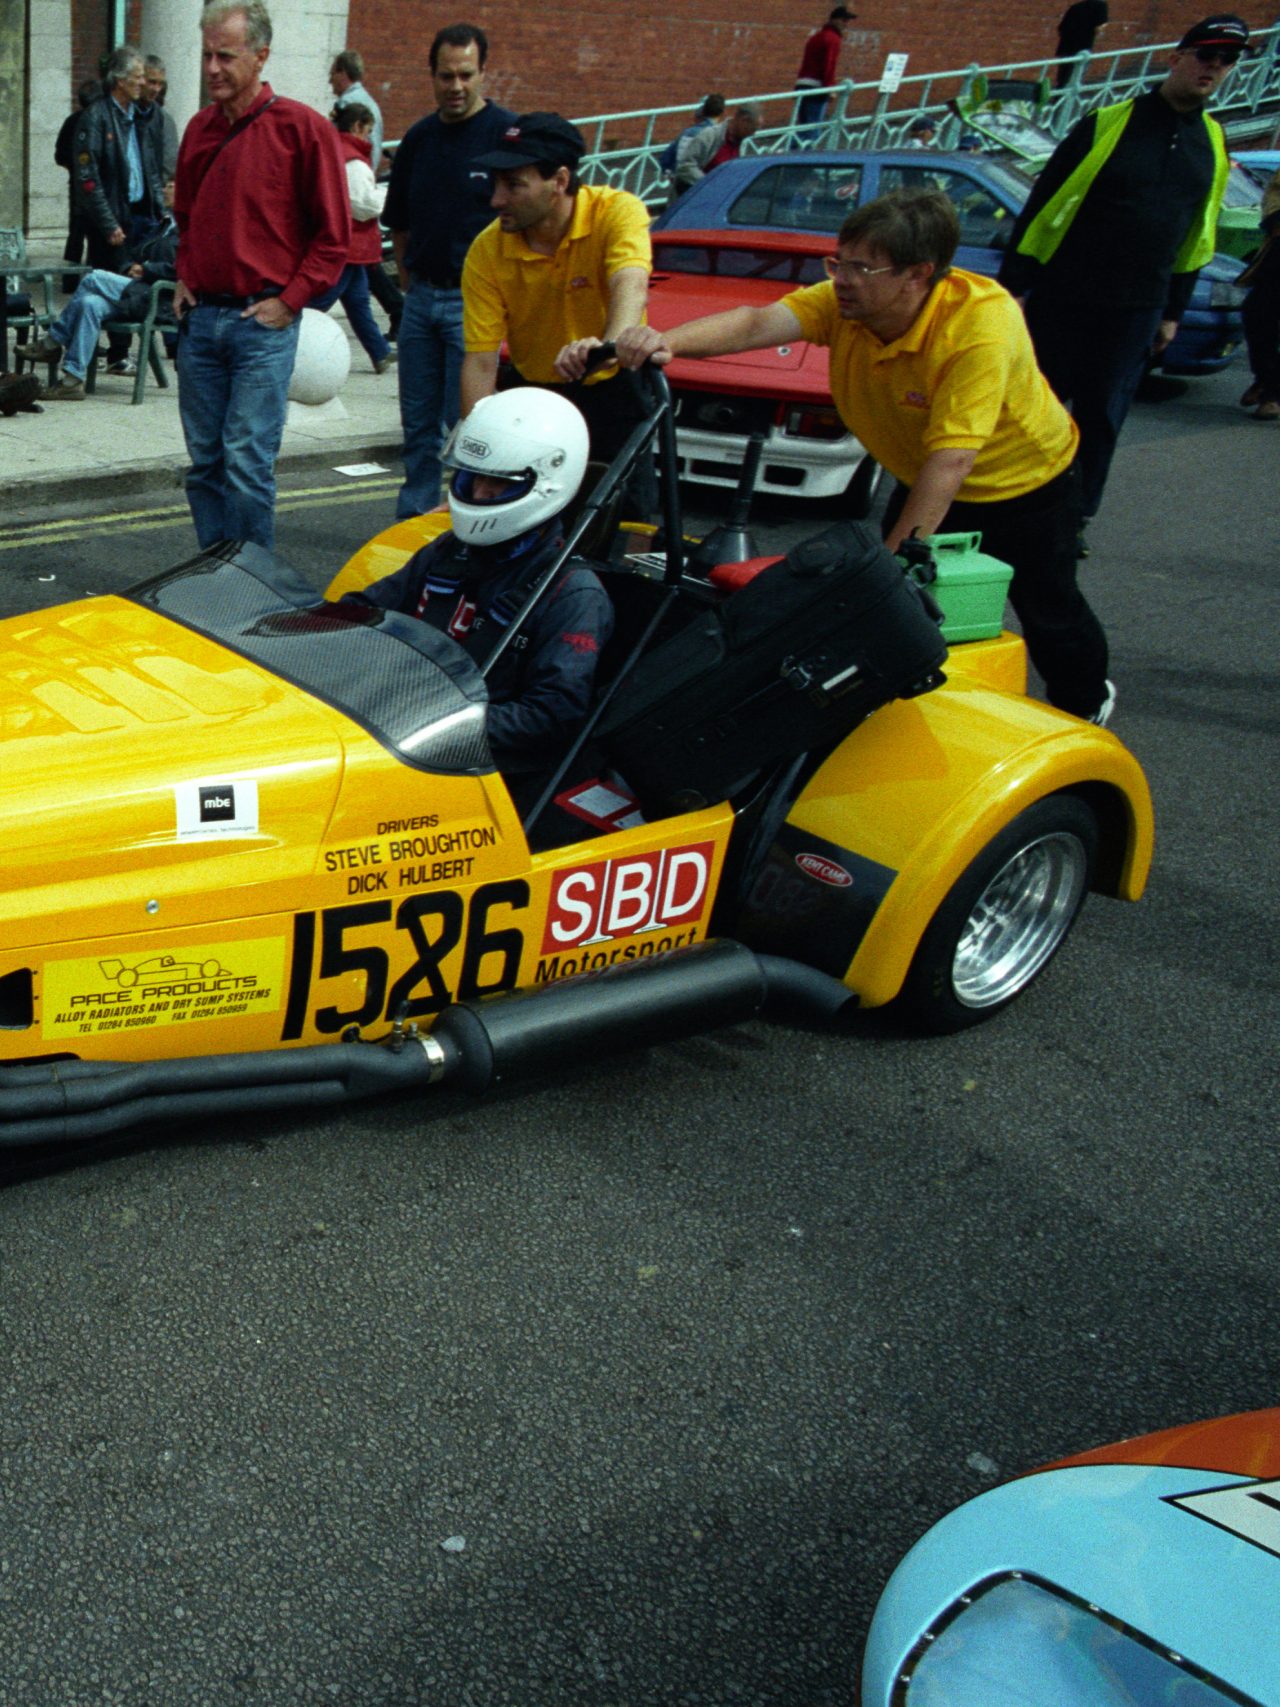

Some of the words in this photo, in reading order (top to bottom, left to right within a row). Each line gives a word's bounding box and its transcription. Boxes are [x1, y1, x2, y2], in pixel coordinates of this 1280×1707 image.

[376, 814, 440, 835] DRIVERS
[324, 844, 383, 872] STEVE
[389, 826, 496, 862] BROUGHTON
[347, 870, 388, 896] DICK
[399, 857, 476, 887] HULBERT
[551, 851, 707, 944] SBD
[534, 926, 697, 984] Motorsport
[54, 1011, 86, 1024] ALLOY
[89, 1004, 145, 1020] RADIATORS
[148, 1001, 170, 1012] AND
[172, 998, 193, 1010] DRY
[194, 994, 224, 1007] SUMP
[226, 988, 271, 1003] SYSTEMS
[70, 990, 132, 1008] PACE
[142, 975, 257, 999] PRODUCTS
[79, 1023, 92, 1033] TEL
[172, 1011, 187, 1021] FAX
